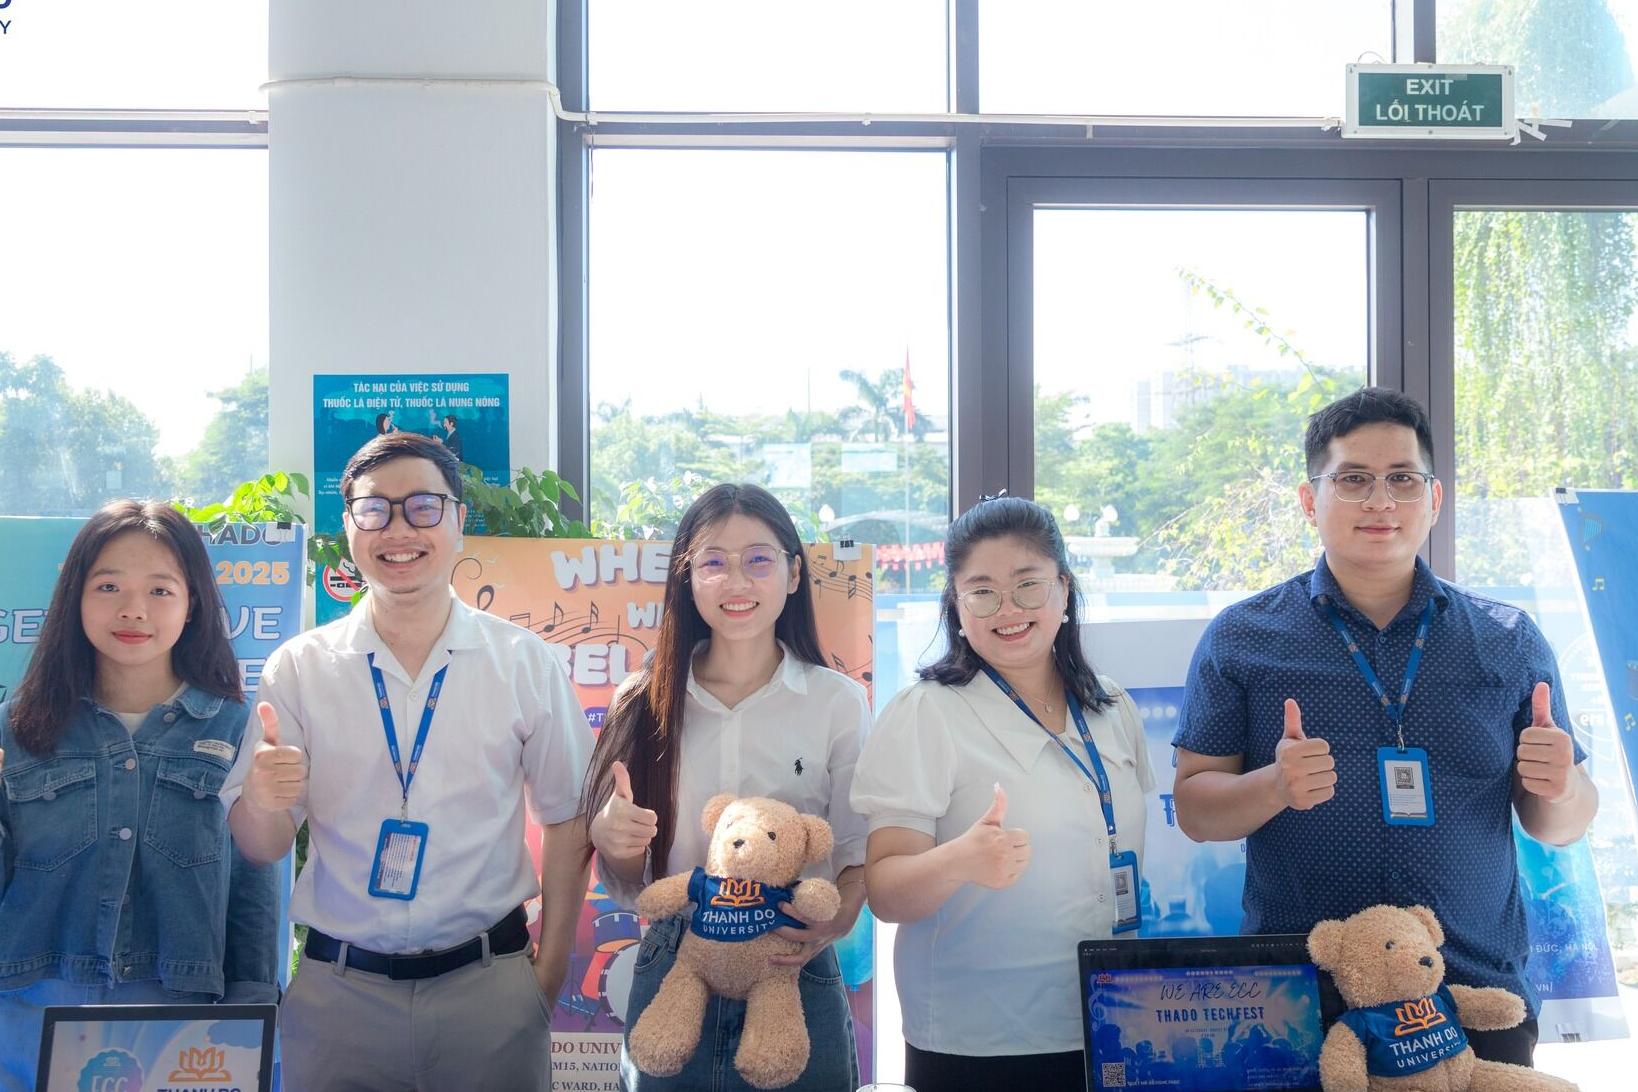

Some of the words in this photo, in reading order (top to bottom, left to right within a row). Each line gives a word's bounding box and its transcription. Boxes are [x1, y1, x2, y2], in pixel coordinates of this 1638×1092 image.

[1406, 79, 1454, 95] EXIT
[1376, 99, 1409, 121] LỐI
[1415, 100, 1485, 121] THOÁT
[354, 381, 370, 393] TÁC
[372, 383, 387, 395] HẠI
[389, 380, 407, 393] CỦA
[410, 382, 429, 394] VIỆC
[445, 382, 469, 394] DỤNG
[323, 396, 351, 408] THUỐC
[367, 397, 387, 410] ĐIỆN
[405, 396, 434, 408] THUỐC
[449, 397, 473, 408] NUNG
[475, 396, 500, 408] NÓNG
[216, 560, 289, 585] 2025
[703, 911, 749, 923] THANH
[754, 909, 775, 920] DO
[703, 920, 775, 935] UNIVERSITY
[1160, 984, 1186, 1001] WE
[1190, 983, 1224, 1001] ARE
[1156, 1008, 1198, 1023] THADO
[1203, 1006, 1265, 1020] TECHFEST
[551, 1041, 575, 1054] DO
[1389, 1031, 1444, 1056] THANH
[1444, 1026, 1458, 1041] DO
[562, 1080, 601, 1092] WARD,
